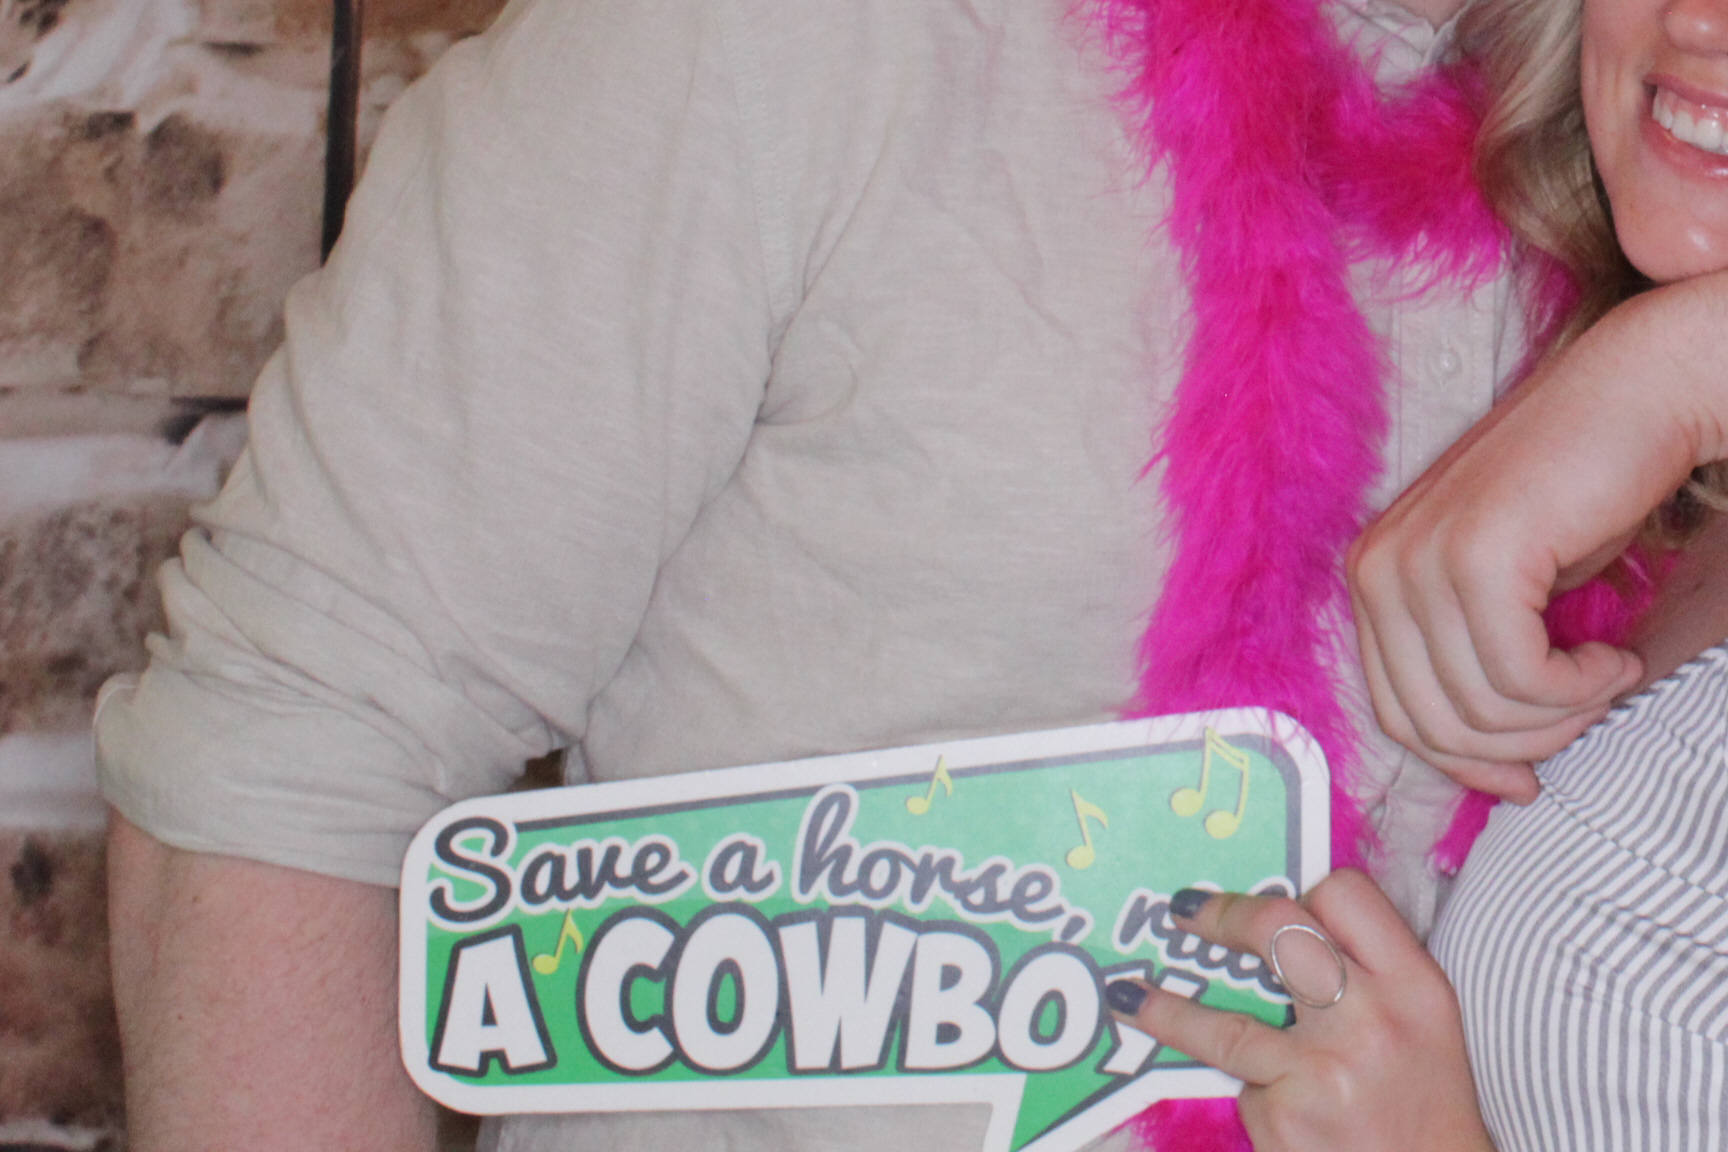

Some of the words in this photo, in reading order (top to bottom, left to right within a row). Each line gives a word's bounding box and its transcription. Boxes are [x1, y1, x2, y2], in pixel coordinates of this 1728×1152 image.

[429, 816, 690, 923] Save
[709, 840, 774, 894] a
[798, 791, 1087, 942] horse,
[428, 923, 557, 1078] A
